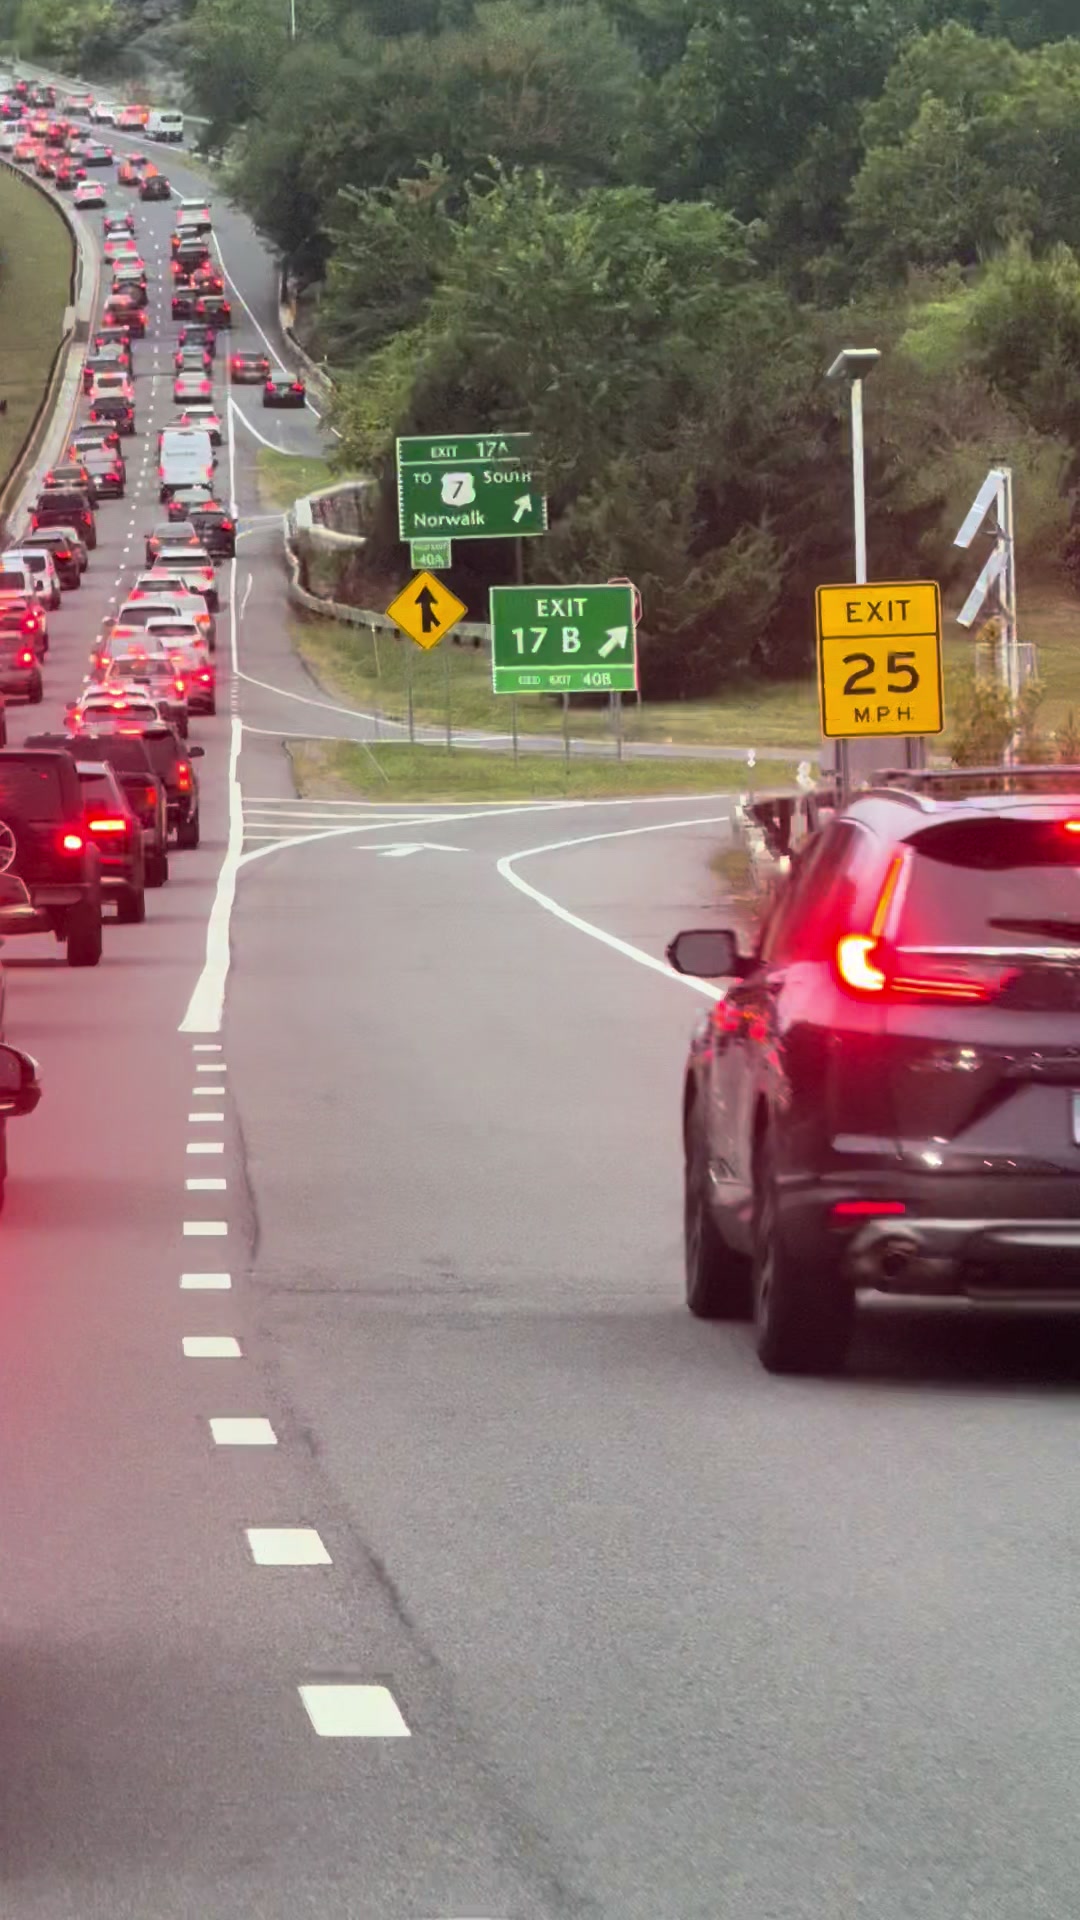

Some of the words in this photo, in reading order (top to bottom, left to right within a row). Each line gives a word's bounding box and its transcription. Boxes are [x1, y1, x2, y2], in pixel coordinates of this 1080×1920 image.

[431, 445, 458, 458] EXIT
[476, 441, 508, 458] 17A
[413, 472, 432, 484] TO
[450, 480, 464, 499] 7
[483, 470, 532, 484] SOUTH
[413, 509, 485, 528] Norwalk
[536, 598, 588, 618] EXIT
[846, 599, 911, 623] EXIT
[512, 627, 547, 654] 17
[562, 627, 581, 653] B
[583, 672, 612, 686] 40B
[842, 651, 920, 696] 25
